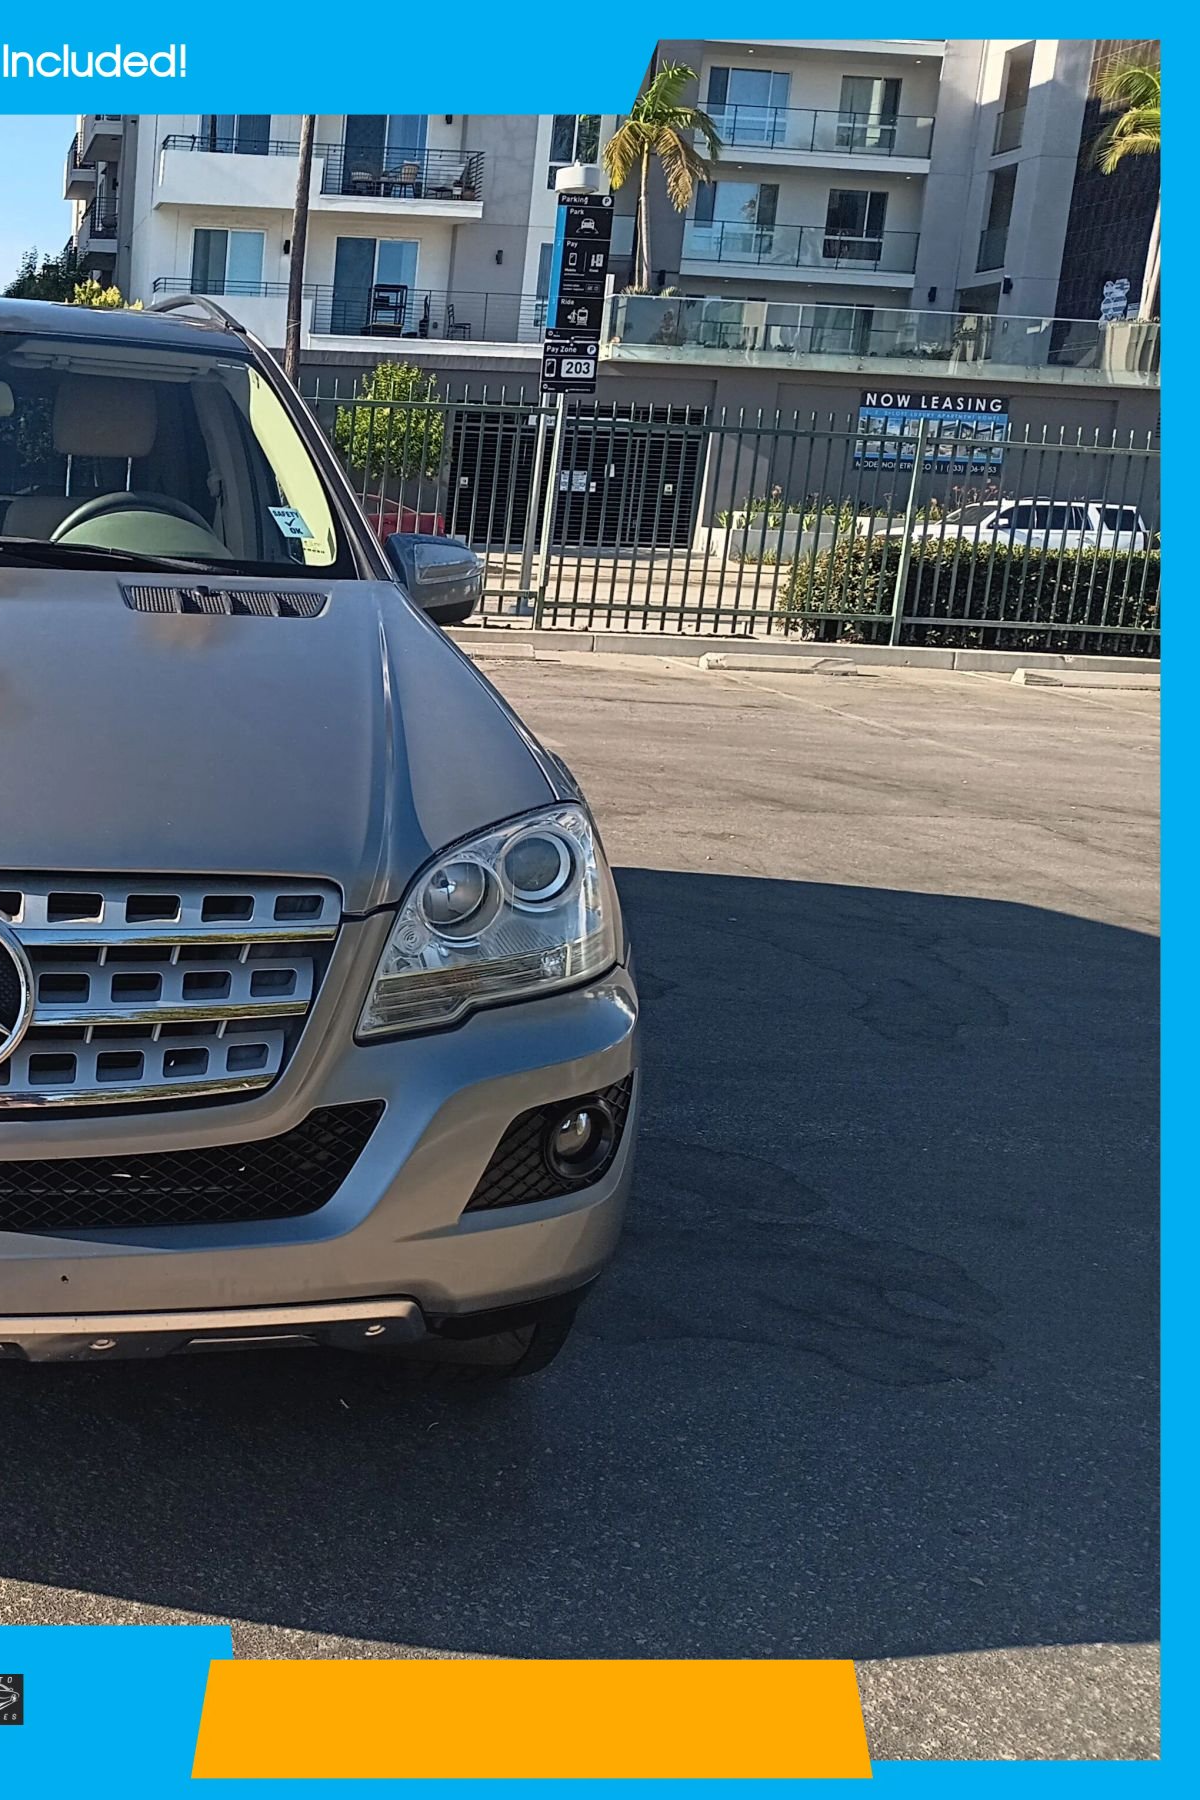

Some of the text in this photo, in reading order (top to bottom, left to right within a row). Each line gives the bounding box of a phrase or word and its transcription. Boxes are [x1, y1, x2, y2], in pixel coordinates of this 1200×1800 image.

[561, 195, 589, 205] Parking
[566, 240, 578, 249] Pay
[546, 345, 560, 354] Pay
[560, 345, 578, 353] Zone
[565, 361, 591, 375] 203
[865, 392, 1003, 412] NOW LEASING
[272, 510, 299, 519] SAFETY
[289, 527, 304, 535] OK
